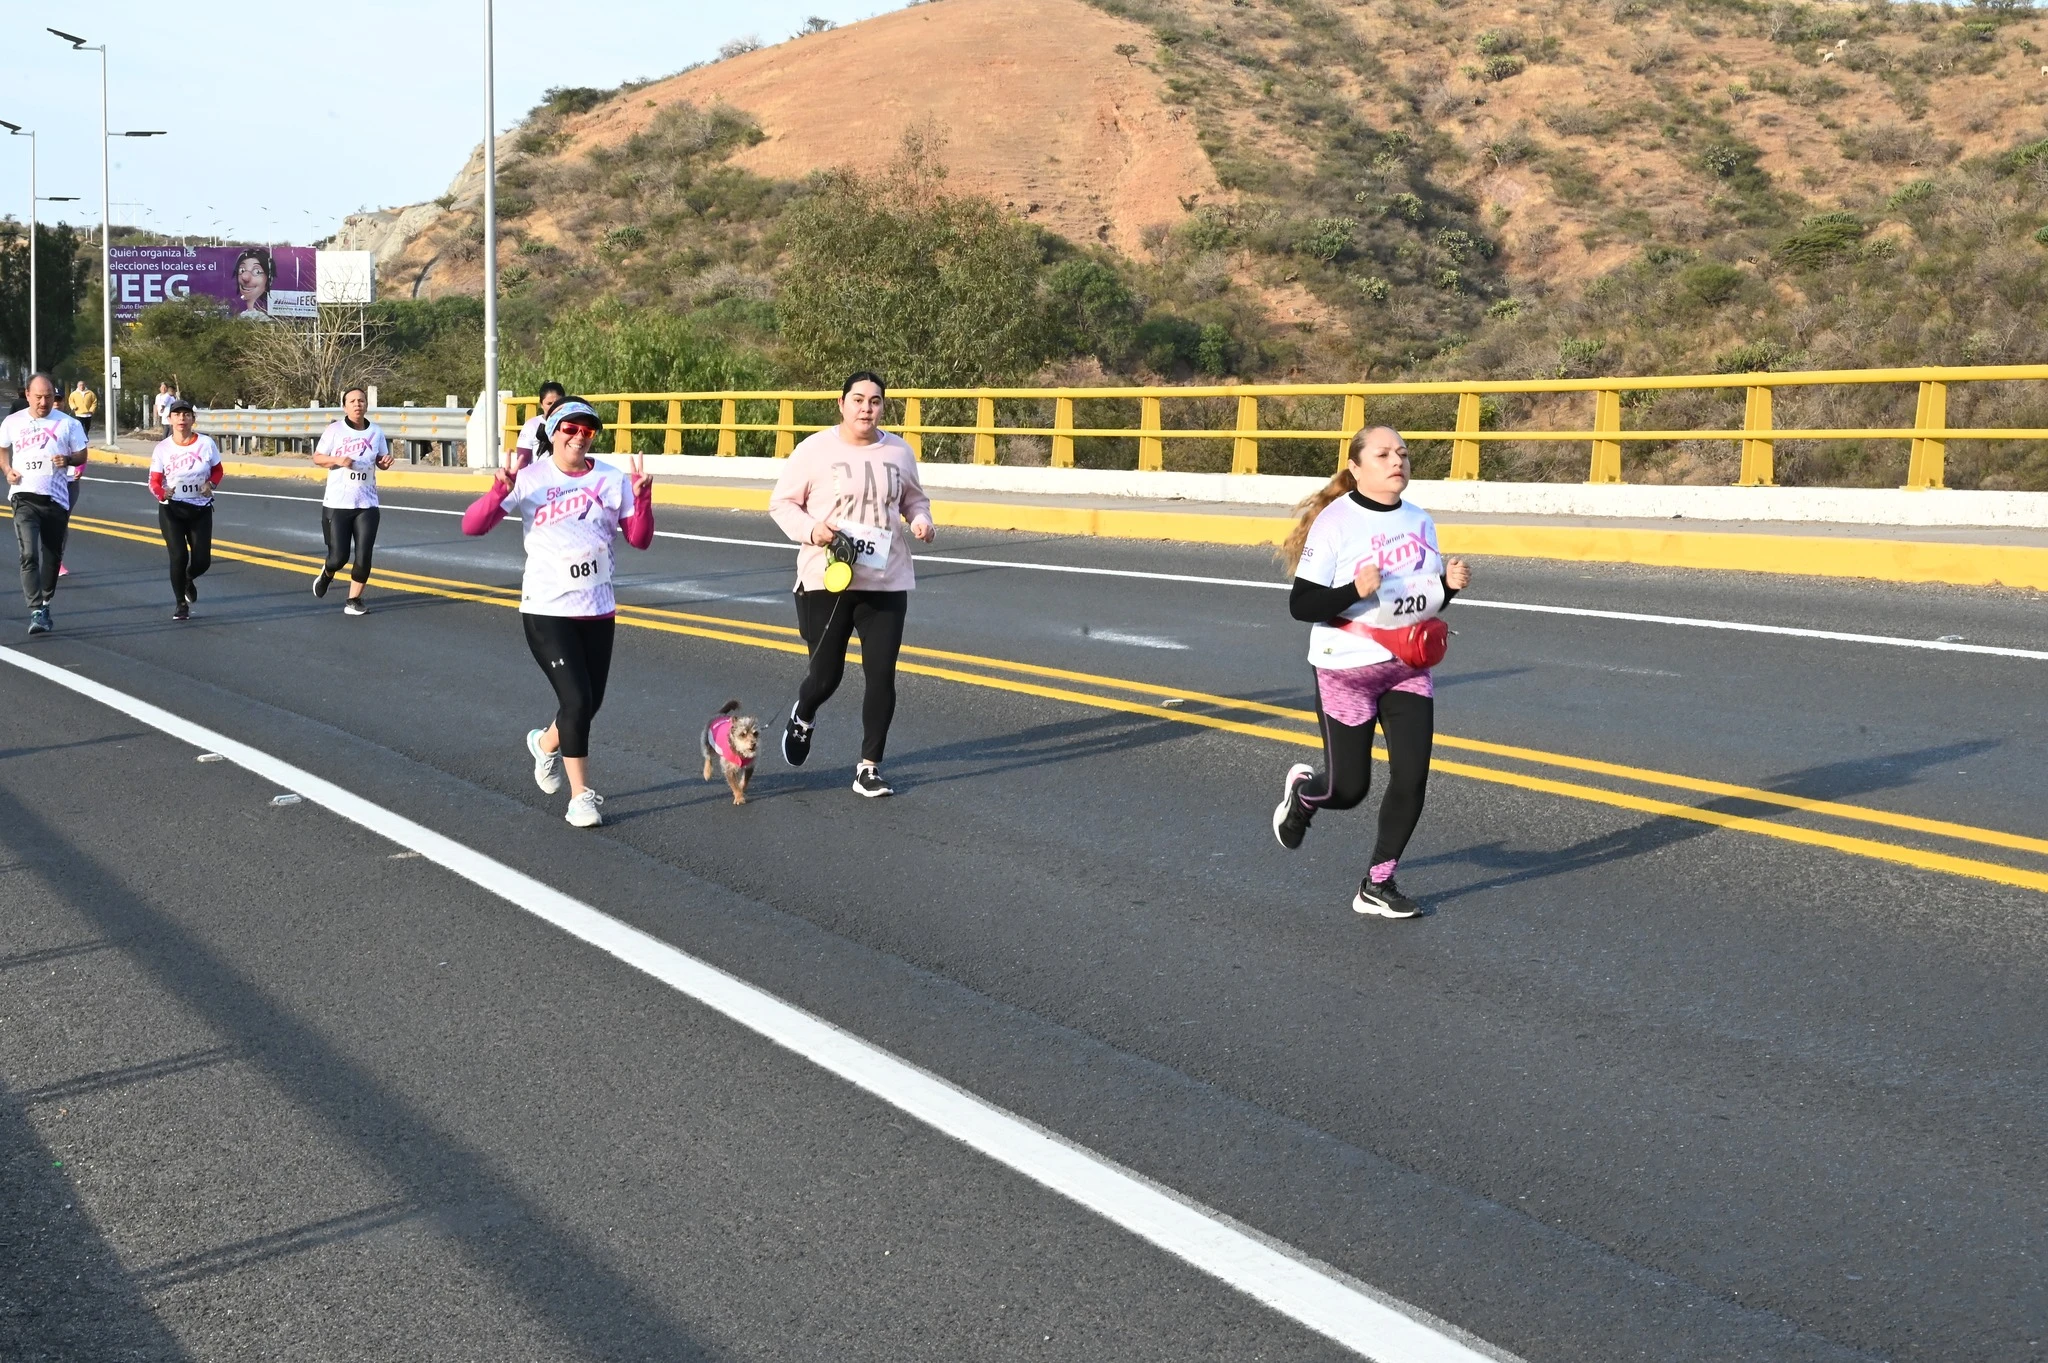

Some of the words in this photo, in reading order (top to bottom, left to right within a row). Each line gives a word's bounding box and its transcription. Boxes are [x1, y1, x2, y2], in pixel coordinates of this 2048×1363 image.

[140, 248, 181, 259] organiza
[183, 248, 197, 258] las
[109, 261, 159, 271] elecciones
[161, 261, 194, 271] locales
[195, 263, 206, 271] es
[208, 261, 217, 271] el
[109, 274, 190, 302] IEEG
[111, 371, 118, 379] 4
[25, 461, 43, 470] 337
[350, 472, 367, 481] 010
[182, 484, 199, 493] 011
[556, 488, 579, 498] carrera
[1381, 533, 1405, 547] carrera
[570, 560, 598, 579] 081
[1393, 594, 1427, 616] 220
